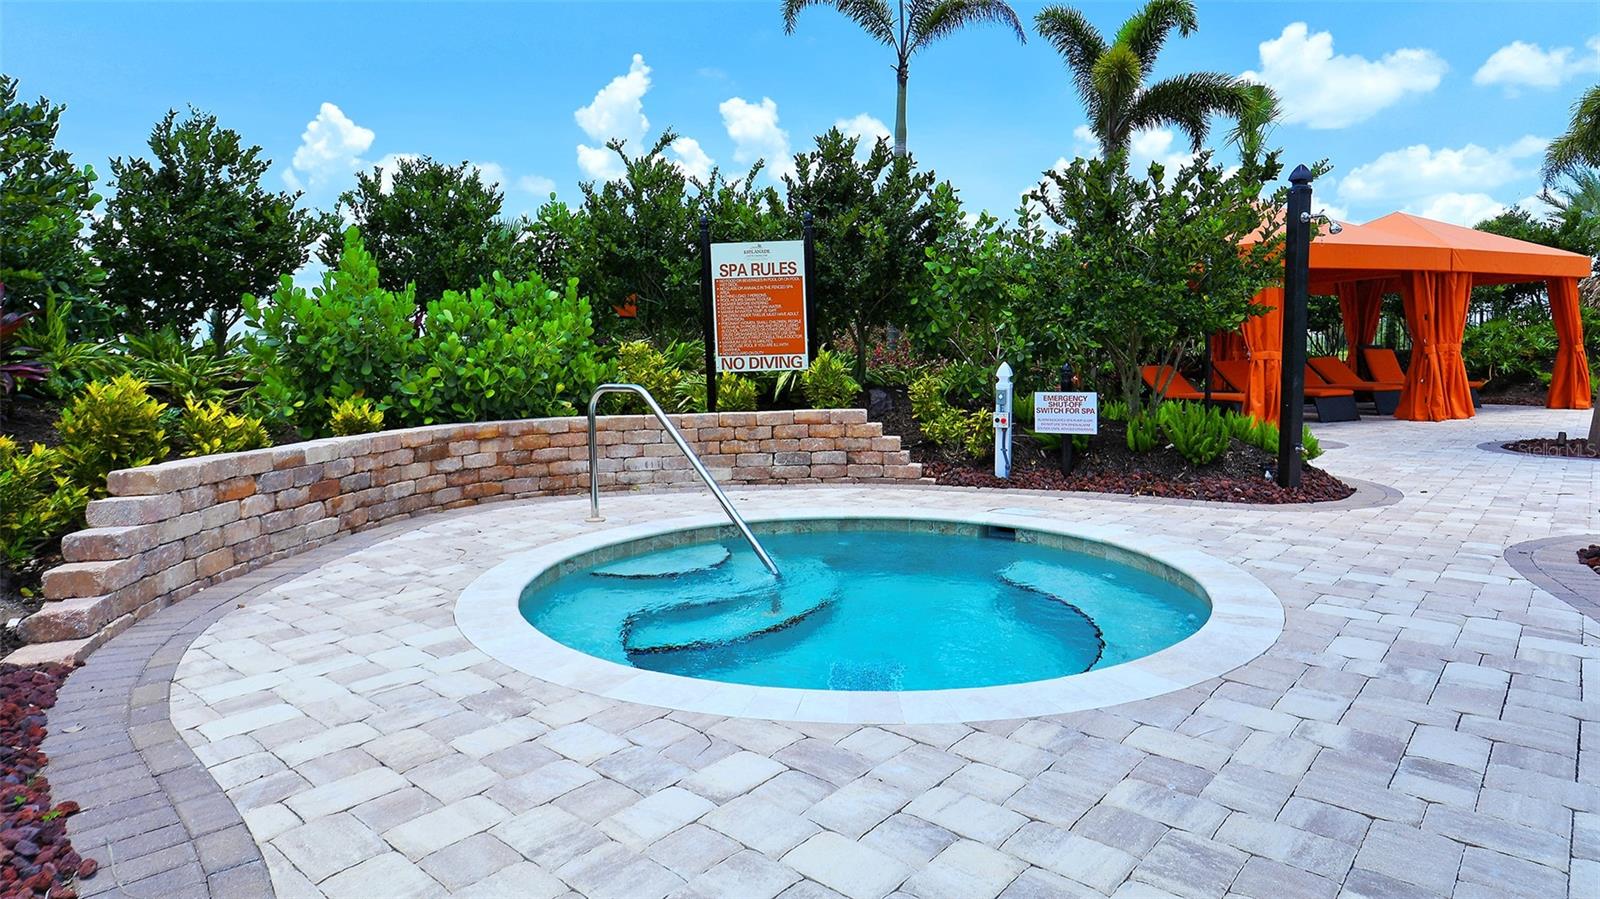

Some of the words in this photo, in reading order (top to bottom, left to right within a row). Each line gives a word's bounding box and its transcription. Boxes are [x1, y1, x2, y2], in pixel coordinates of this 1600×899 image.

[720, 263, 748, 277] SPA
[751, 261, 798, 276] RULES
[722, 357, 745, 370] NO
[749, 356, 803, 369] DIVING
